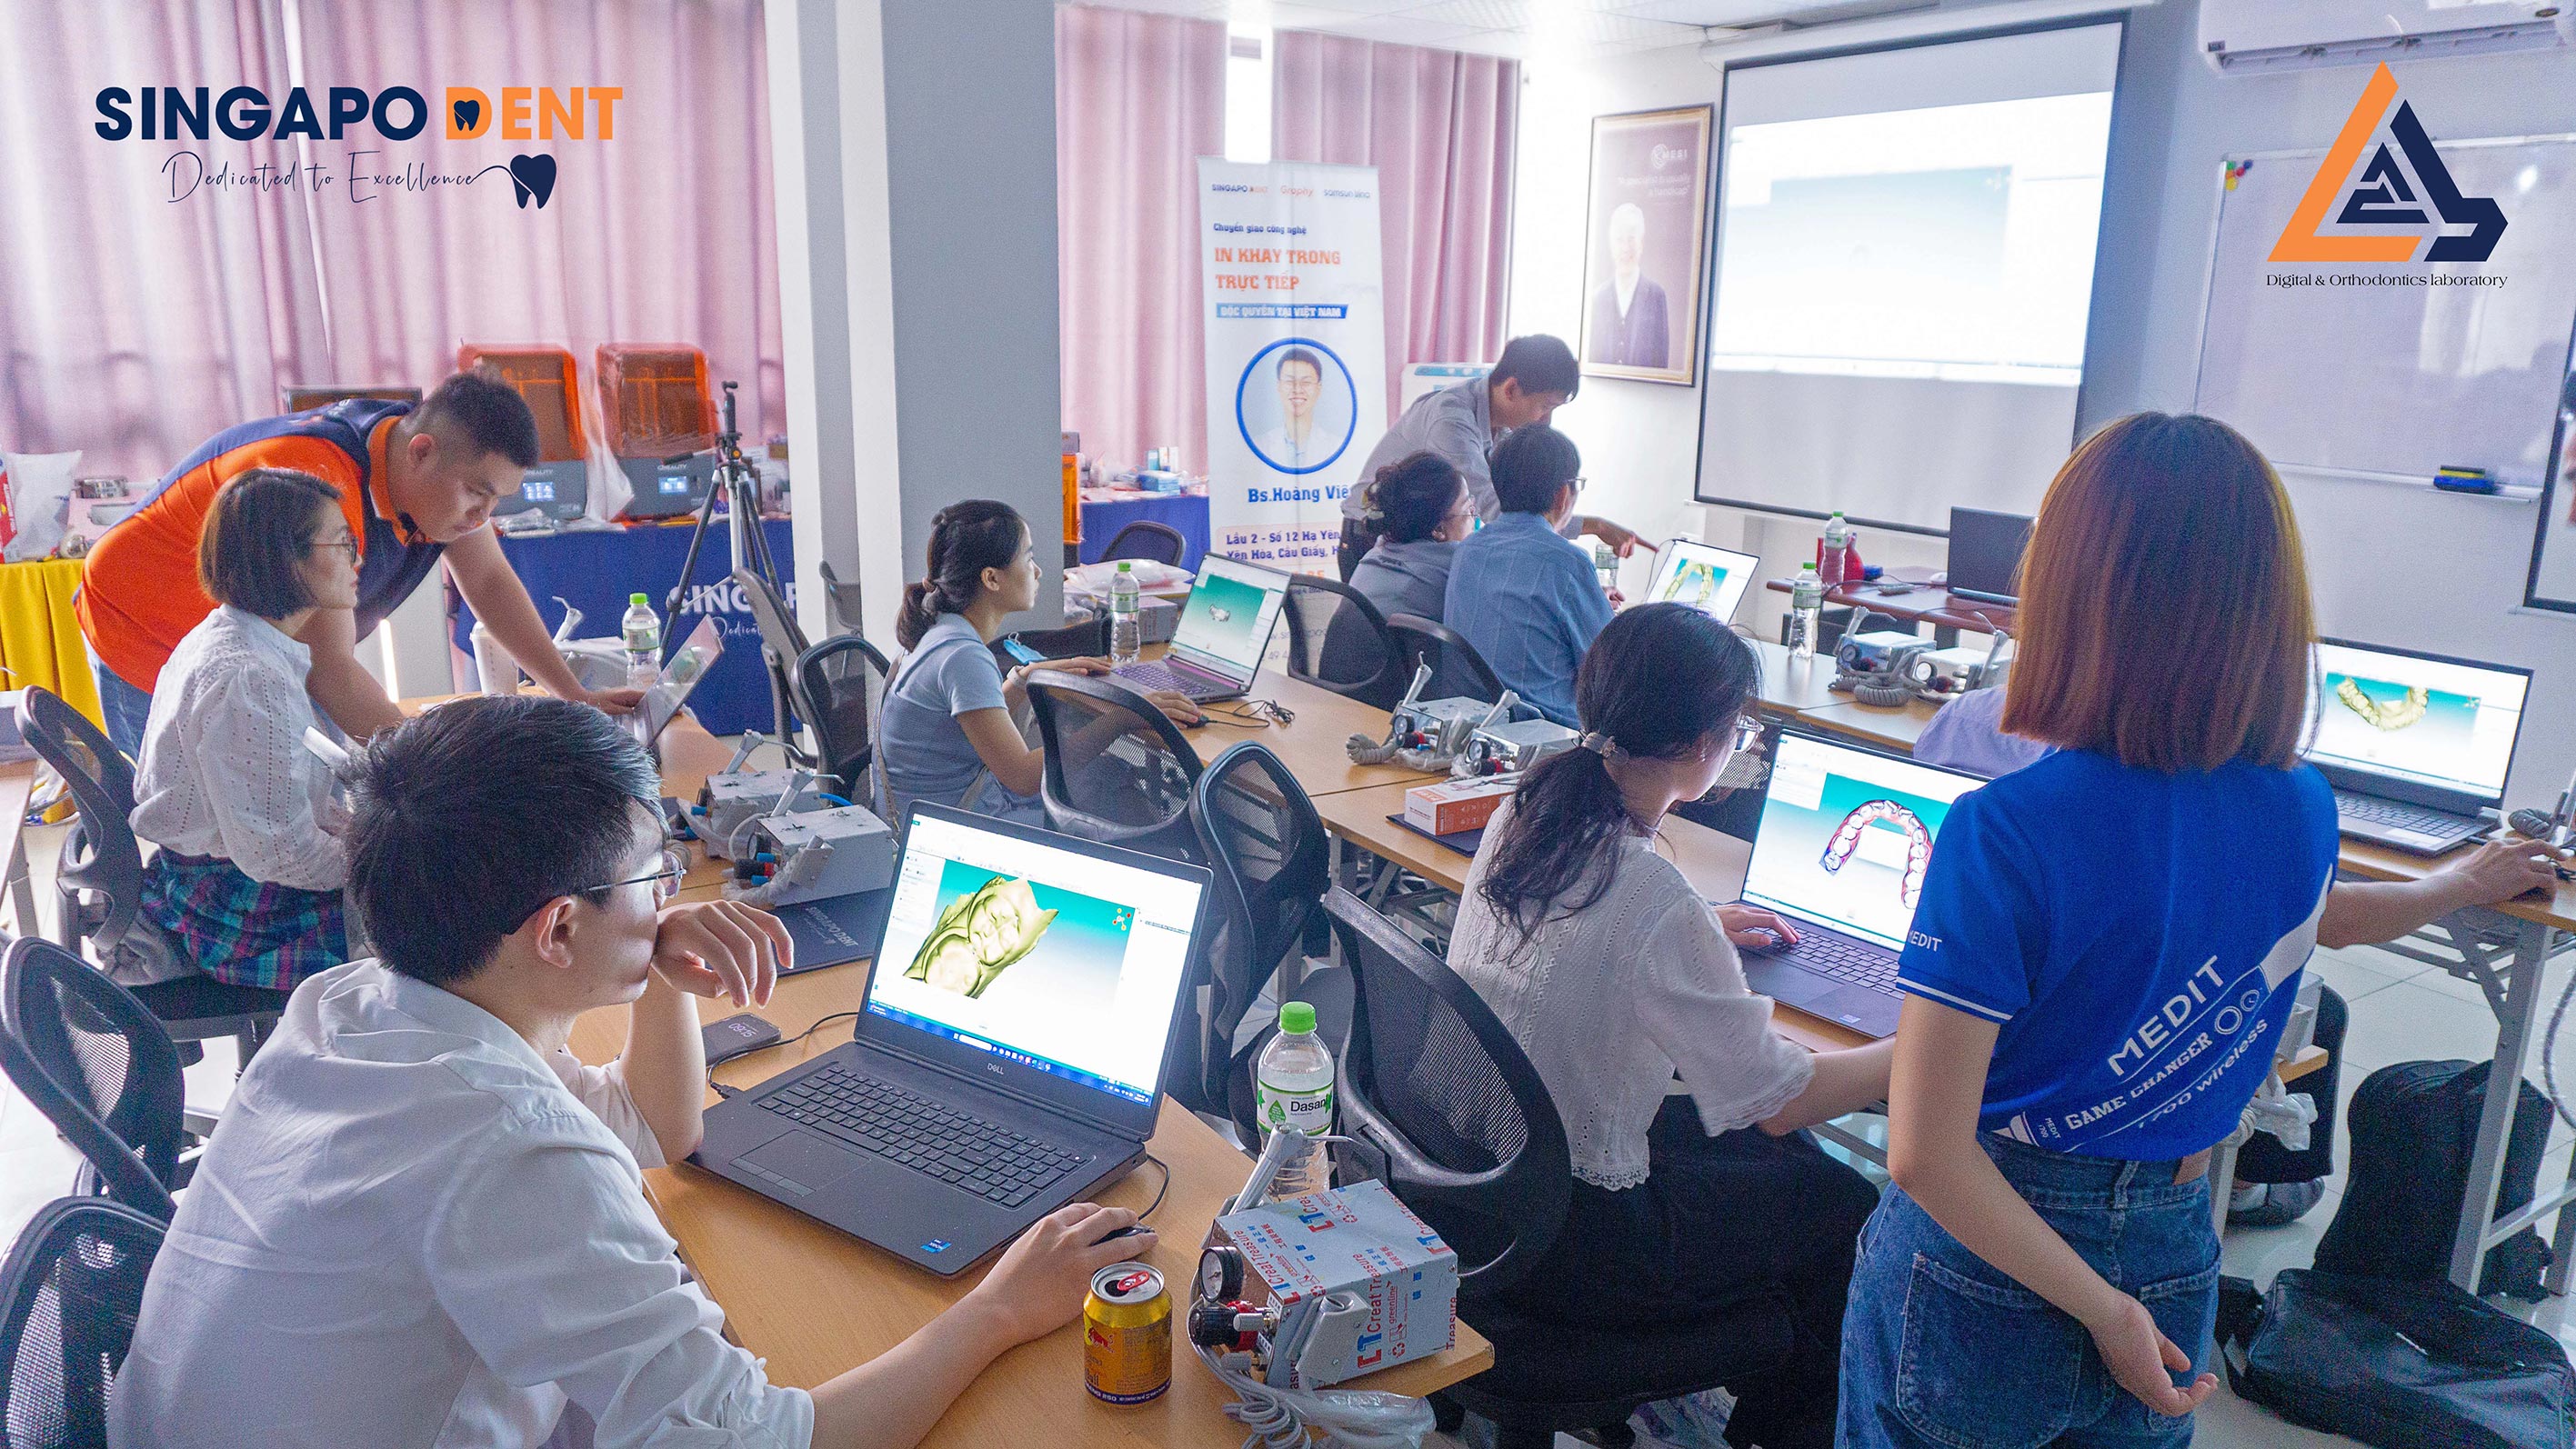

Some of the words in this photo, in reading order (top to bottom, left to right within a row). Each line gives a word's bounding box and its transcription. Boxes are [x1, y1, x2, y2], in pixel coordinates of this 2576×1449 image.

[1247, 224, 1264, 234] giao
[1215, 247, 1233, 263] IN
[1238, 247, 1282, 264] KHAY
[1286, 249, 1341, 265] TRONG
[1215, 274, 1259, 292] TRỰC
[1264, 271, 1299, 290] TIẾP
[1317, 307, 1341, 316] NAM
[1248, 486, 1320, 503] Bs.Hoàng
[1227, 531, 1247, 545] Lầu
[1251, 534, 1258, 544] 2
[1269, 530, 1282, 543] Số
[1286, 532, 1298, 542] 12
[1302, 531, 1317, 543] Hạ
[1251, 549, 1275, 560] Hòa,
[1278, 546, 1298, 558] Cầu
[1301, 544, 1328, 558] Giấy,
[2107, 955, 2228, 1076] MEDIT
[728, 1023, 753, 1038] 09:15
[2196, 1018, 2268, 1092] wireless
[987, 1062, 1004, 1075] DELL
[2066, 1095, 2127, 1130] GAME
[2130, 1032, 2213, 1098] CHANGER
[2045, 1117, 2061, 1139] MEDIT
[1233, 1230, 1267, 1263] Treasure
[1256, 1261, 1285, 1285] Creat
[1353, 1254, 1382, 1293] Treasure
[1367, 1293, 1382, 1333] Creat
[1388, 1285, 1398, 1324] greenline
